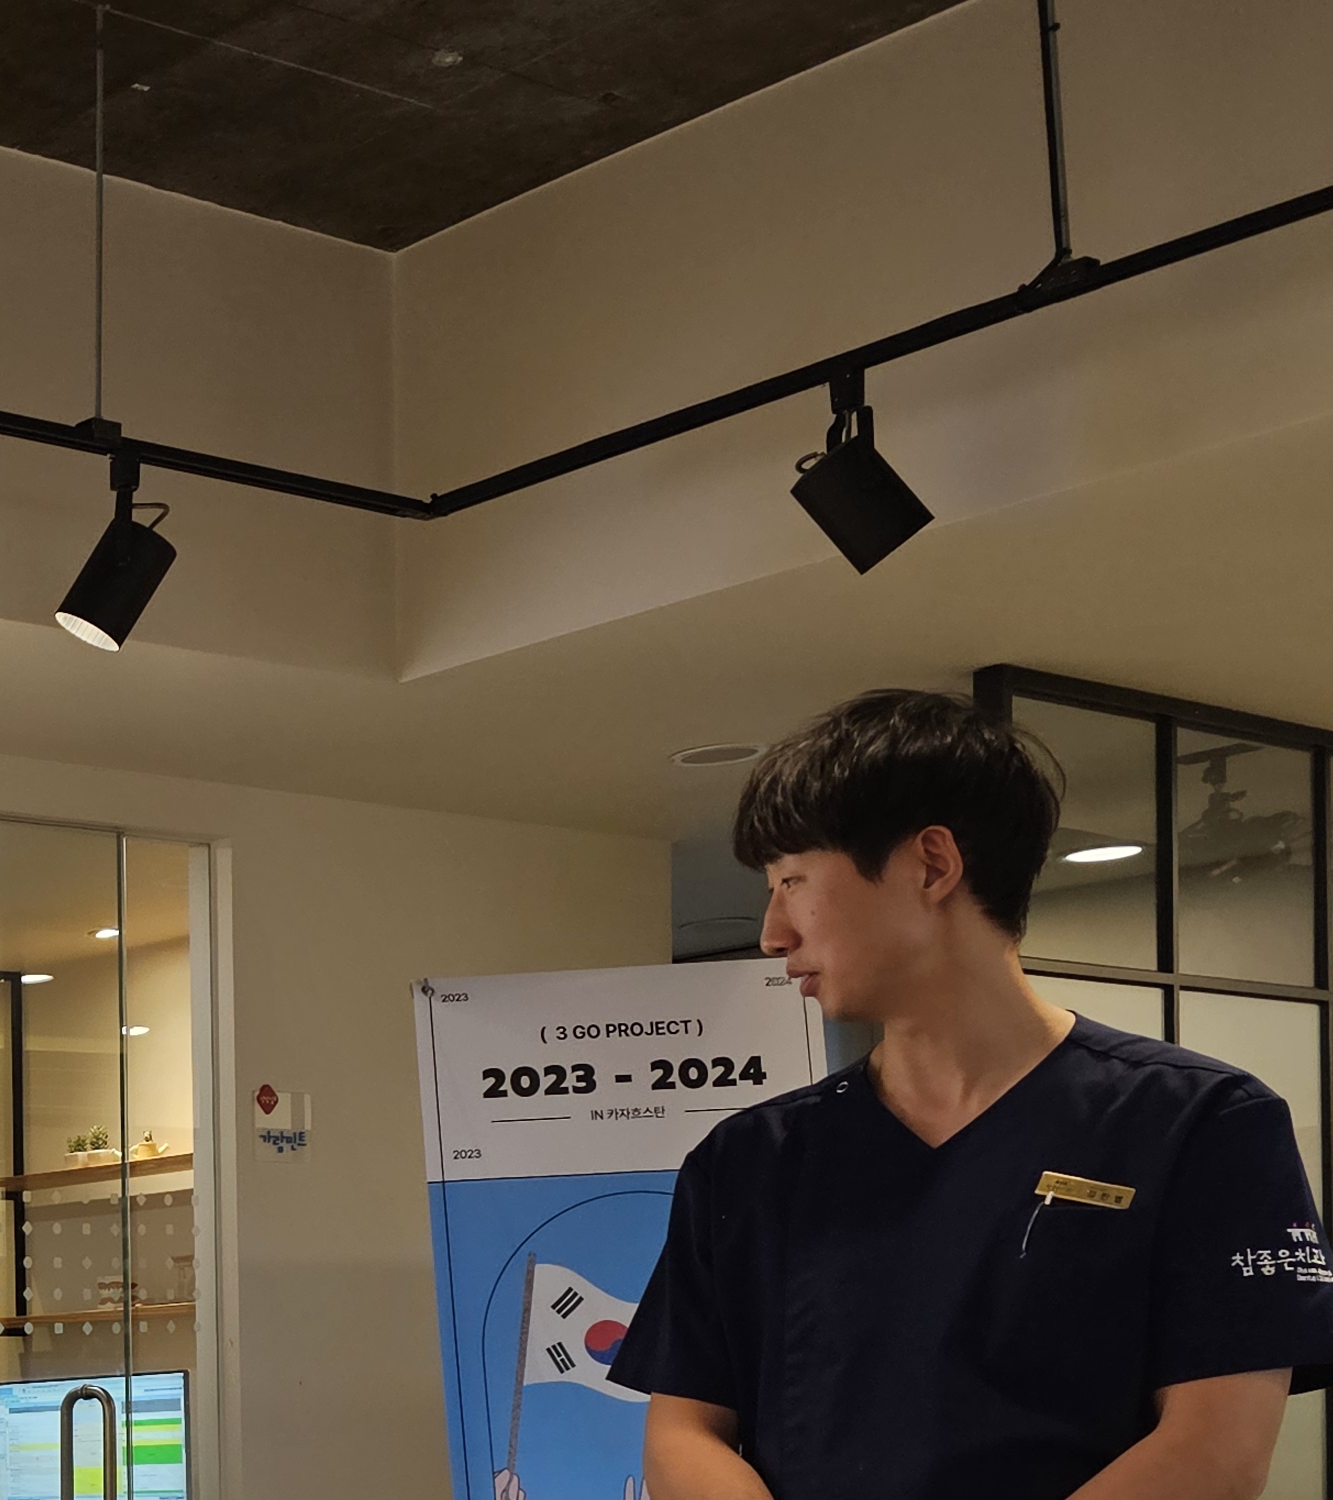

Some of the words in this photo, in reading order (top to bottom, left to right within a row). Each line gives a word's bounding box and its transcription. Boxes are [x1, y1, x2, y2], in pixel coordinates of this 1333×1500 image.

[440, 992, 469, 1003] 2023
[555, 1026, 568, 1041] 3
[572, 1024, 601, 1040] GO
[605, 1019, 693, 1039] PROJECT
[482, 1063, 597, 1099] 2023
[650, 1055, 767, 1091] 2024
[590, 1109, 604, 1121] IN
[606, 1105, 666, 1121] 카자흐스탄
[452, 1149, 482, 1160] 2023
[1231, 1245, 1327, 1277] 참좋은치과
